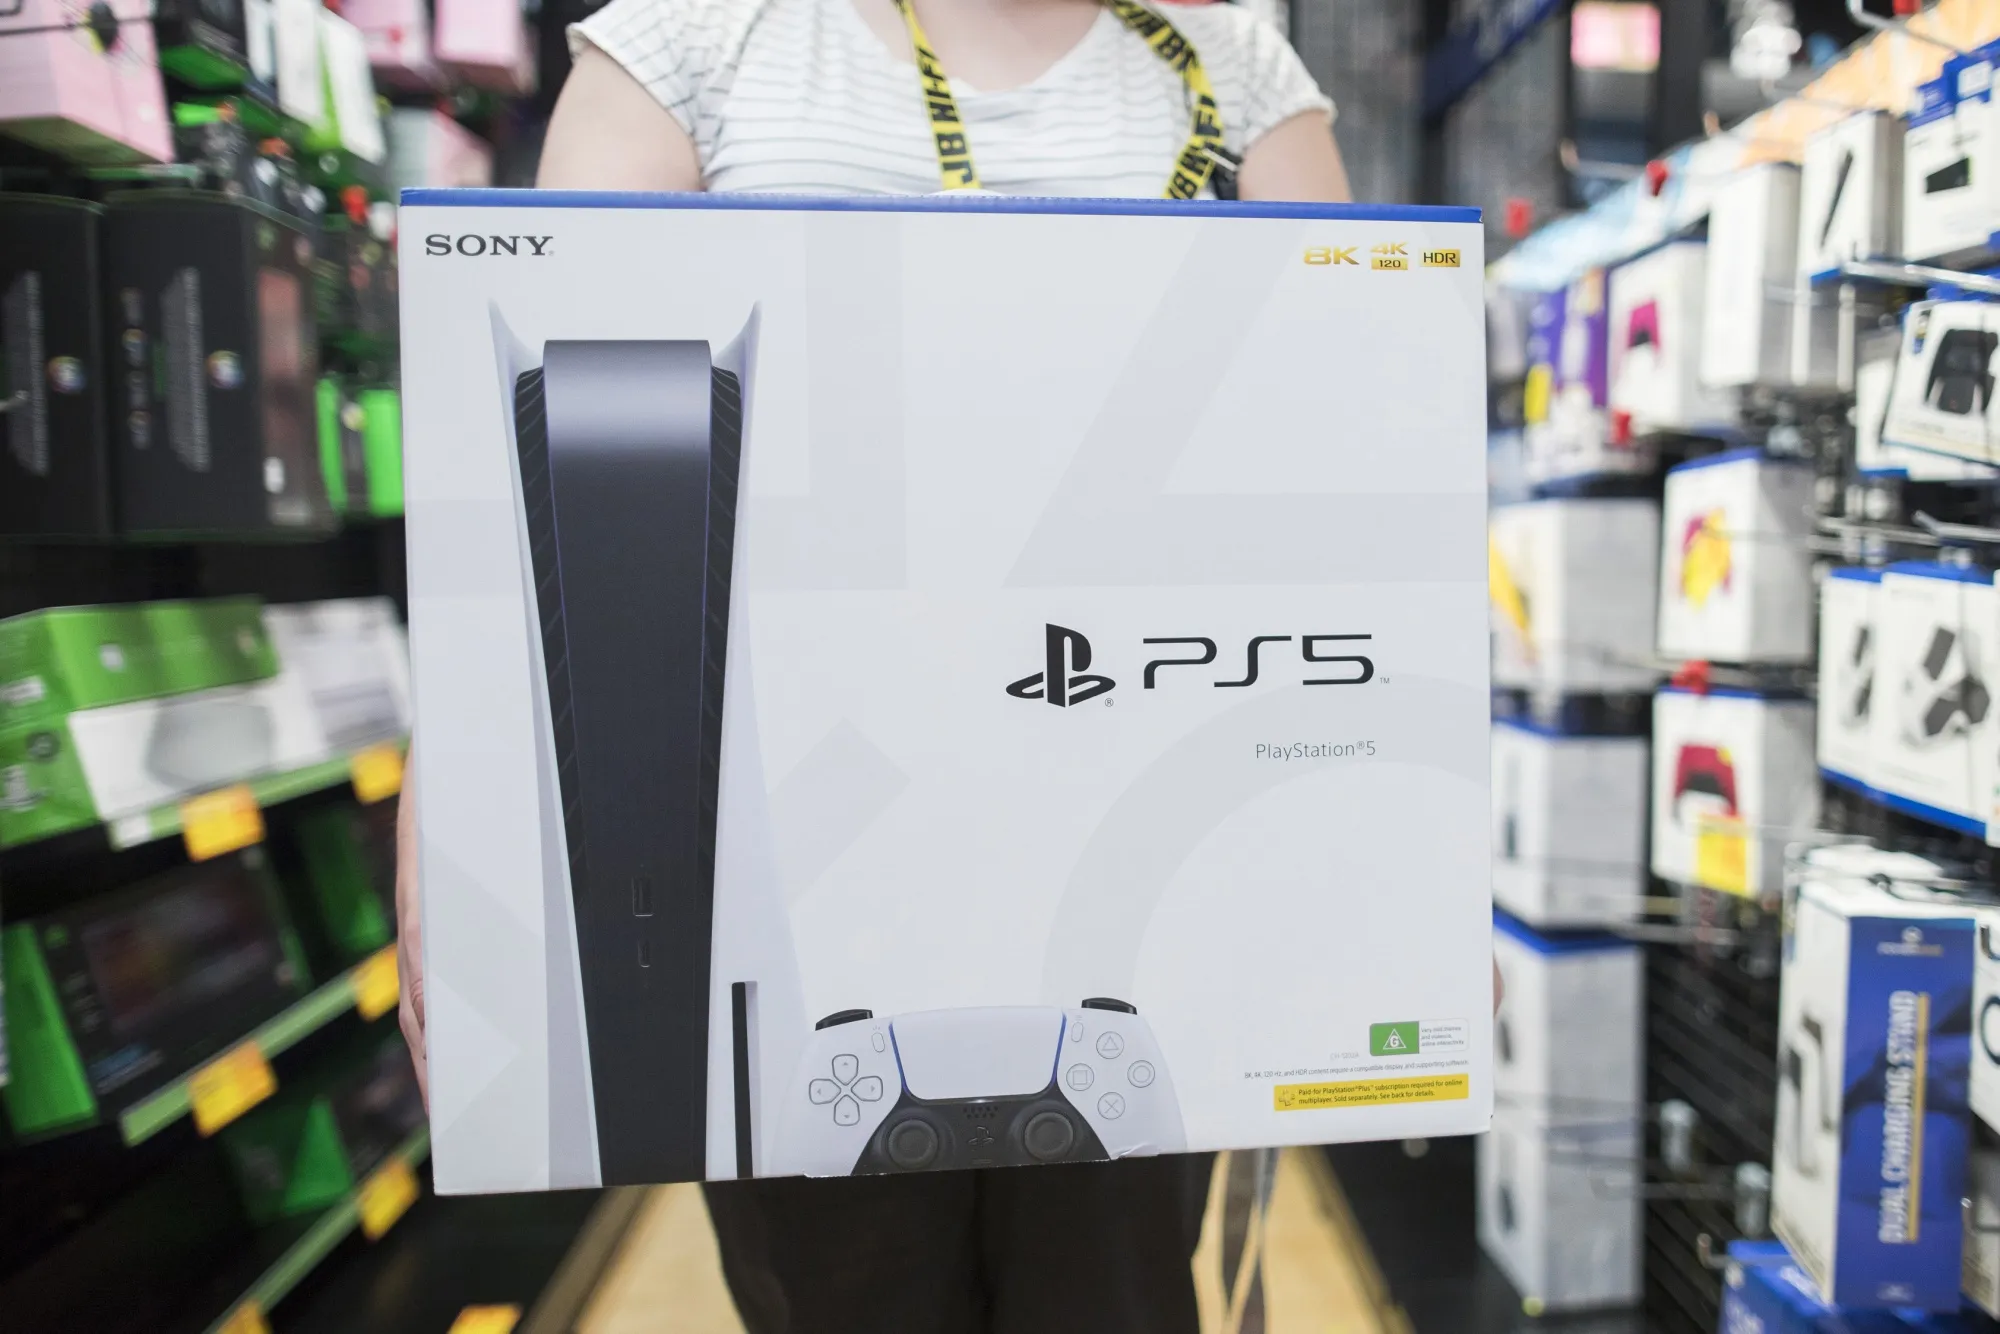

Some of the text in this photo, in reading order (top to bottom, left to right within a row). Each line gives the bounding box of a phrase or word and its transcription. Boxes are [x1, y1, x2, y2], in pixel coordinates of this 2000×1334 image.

[918, 48, 974, 184] JB HI-FI
[424, 233, 554, 257] SONY
[1370, 241, 1409, 256] 4K
[1303, 245, 1360, 266] 8K
[1423, 252, 1456, 264] HDR
[1379, 259, 1401, 268] 120
[1143, 633, 1375, 690] PS5
[1389, 1035, 1400, 1048] G
[1295, 1068, 1308, 1076] HDR
[1416, 1060, 1444, 1069] supporting
[1298, 1088, 1311, 1096] Paid
[1374, 1083, 1409, 1092] subscription
[1410, 1081, 1435, 1090] required
[1334, 1094, 1347, 1102] Sold
[1391, 1091, 1404, 1099] back
[1414, 1089, 1435, 1097] details.
